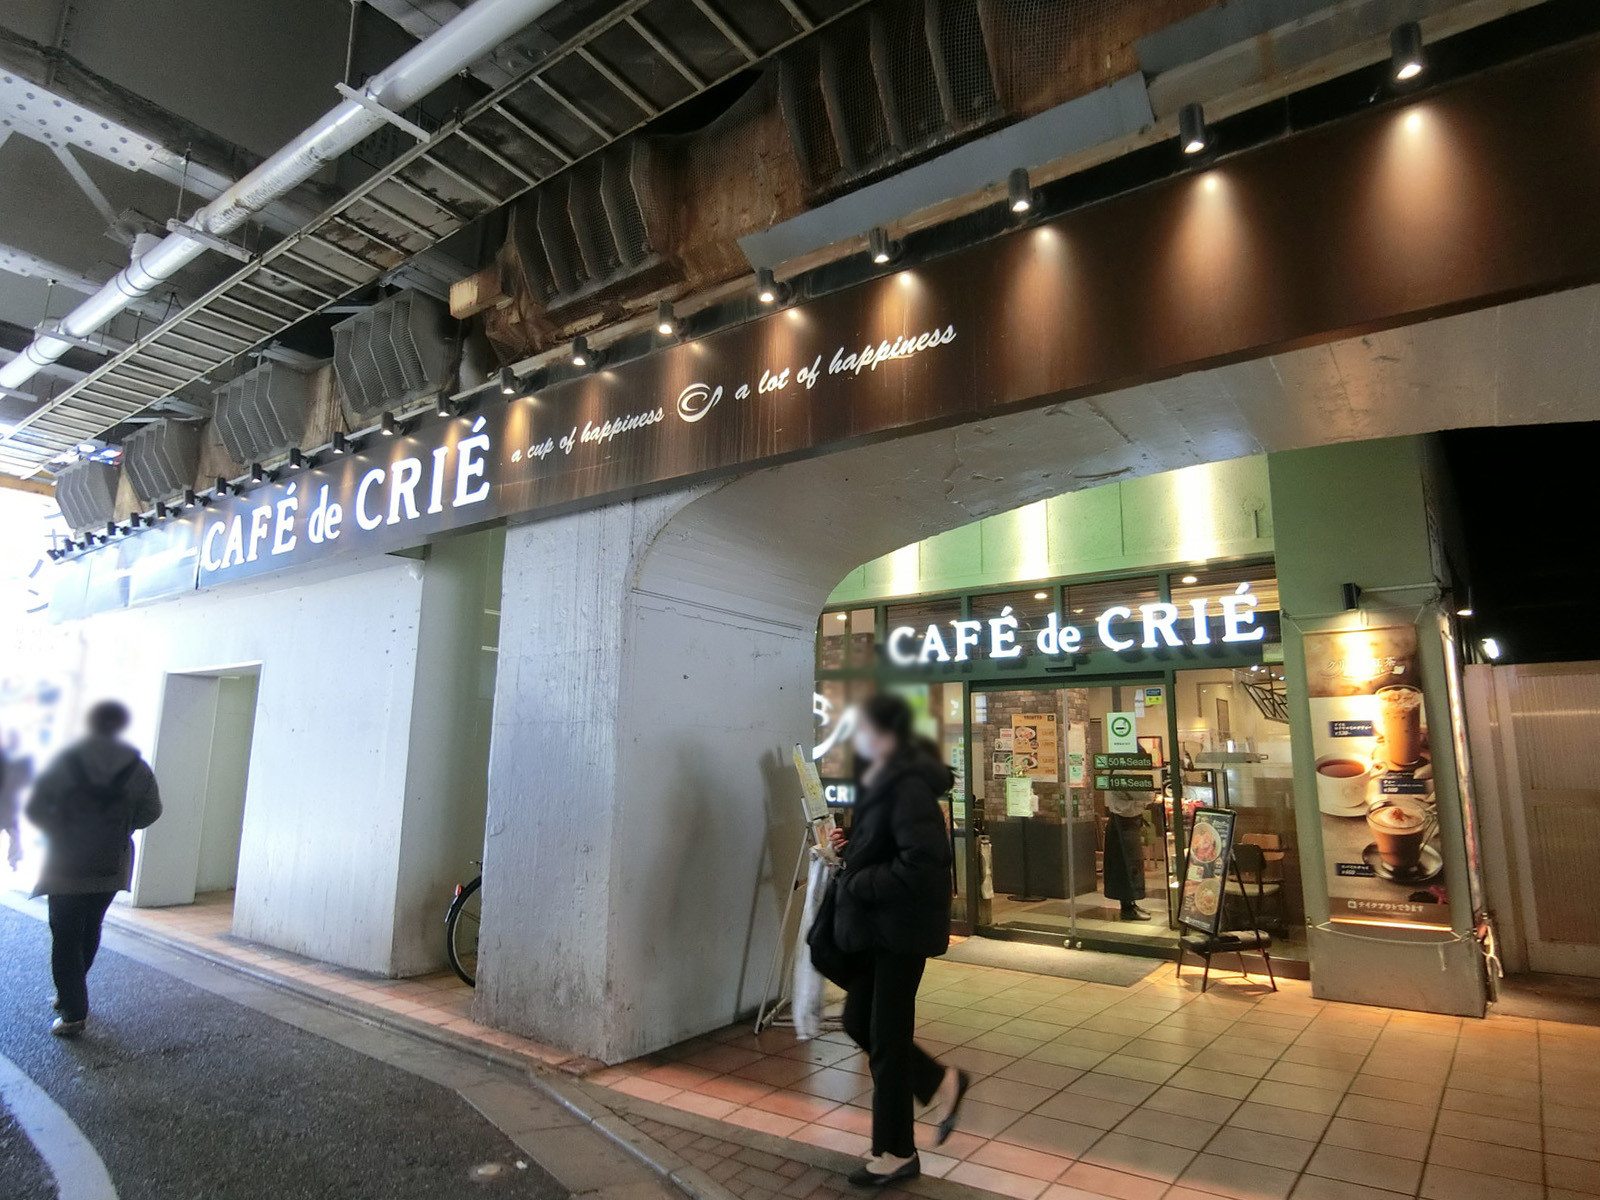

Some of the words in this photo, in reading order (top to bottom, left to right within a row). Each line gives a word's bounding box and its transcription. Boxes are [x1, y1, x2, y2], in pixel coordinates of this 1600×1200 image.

[737, 384, 751, 401] a
[758, 367, 790, 395] lot
[796, 355, 821, 389] of
[829, 325, 957, 376] happiness
[511, 449, 523, 463] a
[527, 437, 554, 460] cup
[559, 426, 577, 455] of
[580, 407, 665, 445] happiness
[200, 481, 299, 572] CAFÉ
[308, 484, 343, 544] de
[355, 415, 491, 531] CRIÉ
[887, 605, 1024, 666] CAFÉ
[1036, 612, 1081, 655] de
[1096, 582, 1266, 652] CRIÉ
[1108, 758, 1119, 767] 50
[1127, 758, 1151, 767] Seats
[1109, 780, 1120, 788] 19
[1128, 779, 1153, 788] Seats
